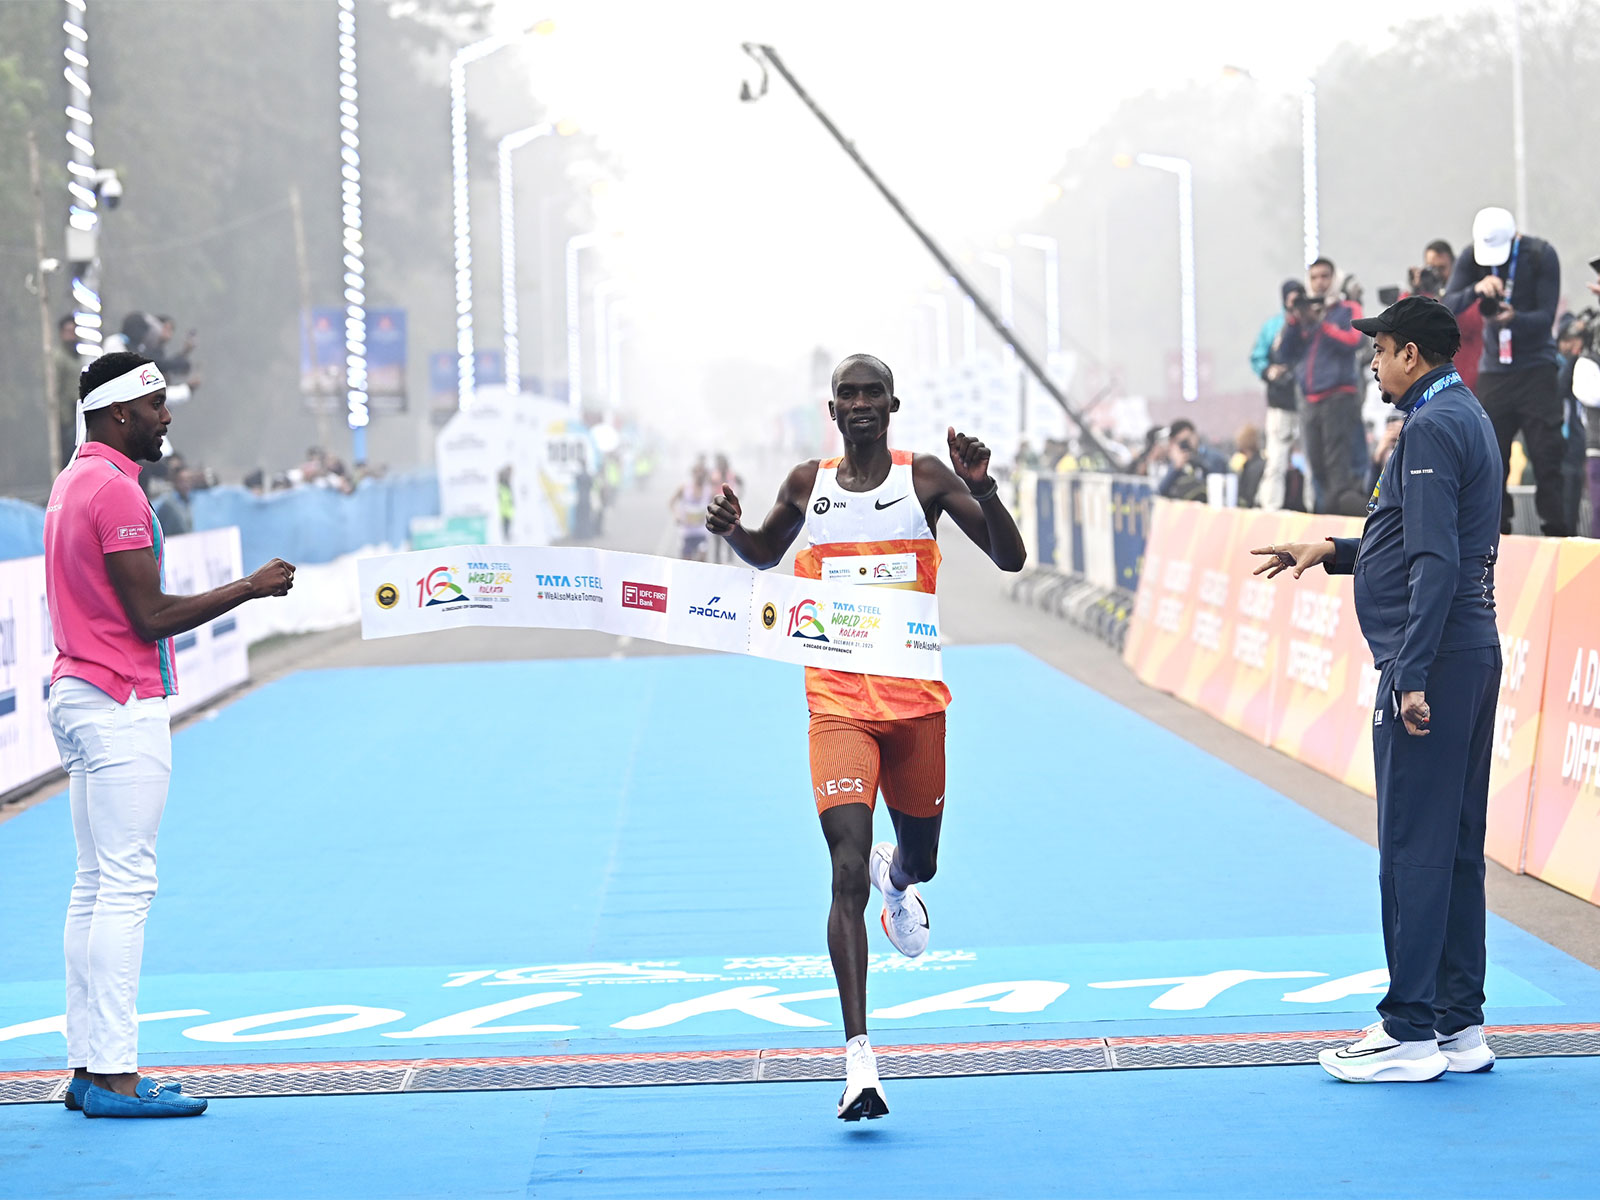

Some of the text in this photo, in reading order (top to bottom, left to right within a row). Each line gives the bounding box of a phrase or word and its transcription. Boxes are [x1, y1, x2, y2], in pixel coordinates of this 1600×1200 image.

[467, 562, 512, 571] TATA STEEL
[536, 574, 604, 590] TATA STEEL
[639, 590, 667, 601] IDFC FIRST
[639, 598, 653, 607] Bank
[688, 605, 736, 621] PROCAM
[832, 601, 882, 615] TATA STEEL
[831, 612, 881, 629] WORLD 25K
[838, 627, 869, 639] KOLKATA
[906, 621, 938, 637] TATA
[1566, 647, 1583, 705] A
